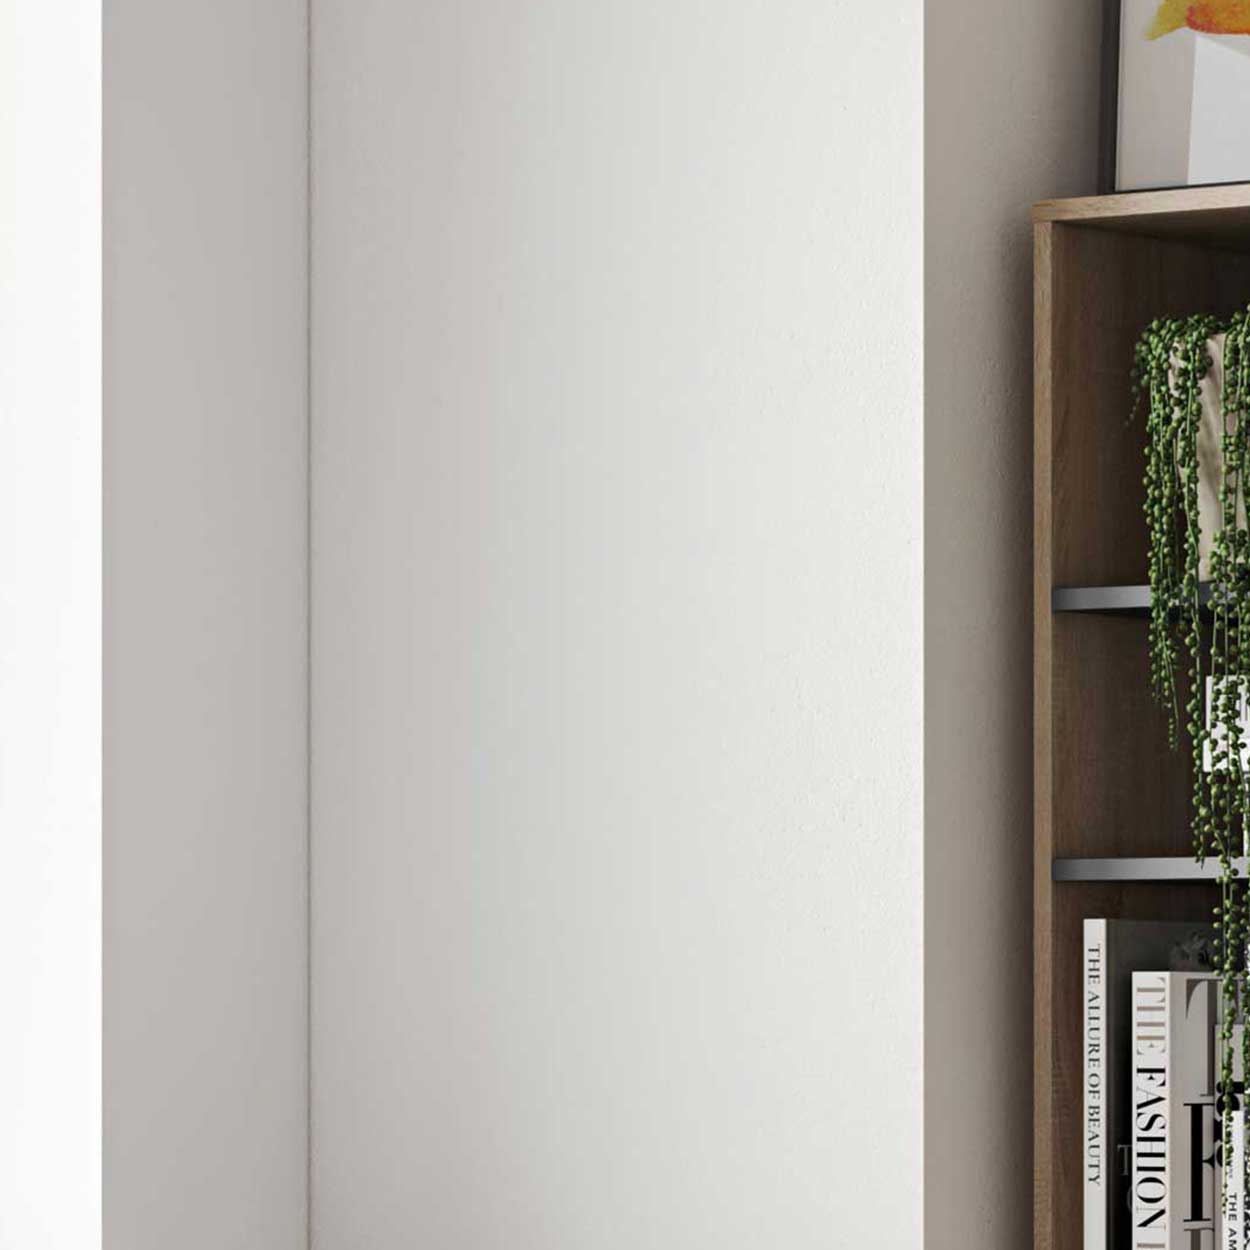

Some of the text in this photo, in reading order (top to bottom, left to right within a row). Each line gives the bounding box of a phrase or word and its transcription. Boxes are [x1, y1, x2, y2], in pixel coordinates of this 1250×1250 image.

[1088, 943, 1102, 1187] THE ALLURE OF BEAUTY
[1136, 976, 1167, 1056] THE
[1136, 1066, 1167, 1232] FASHION
[1228, 1193, 1238, 1221] THE
